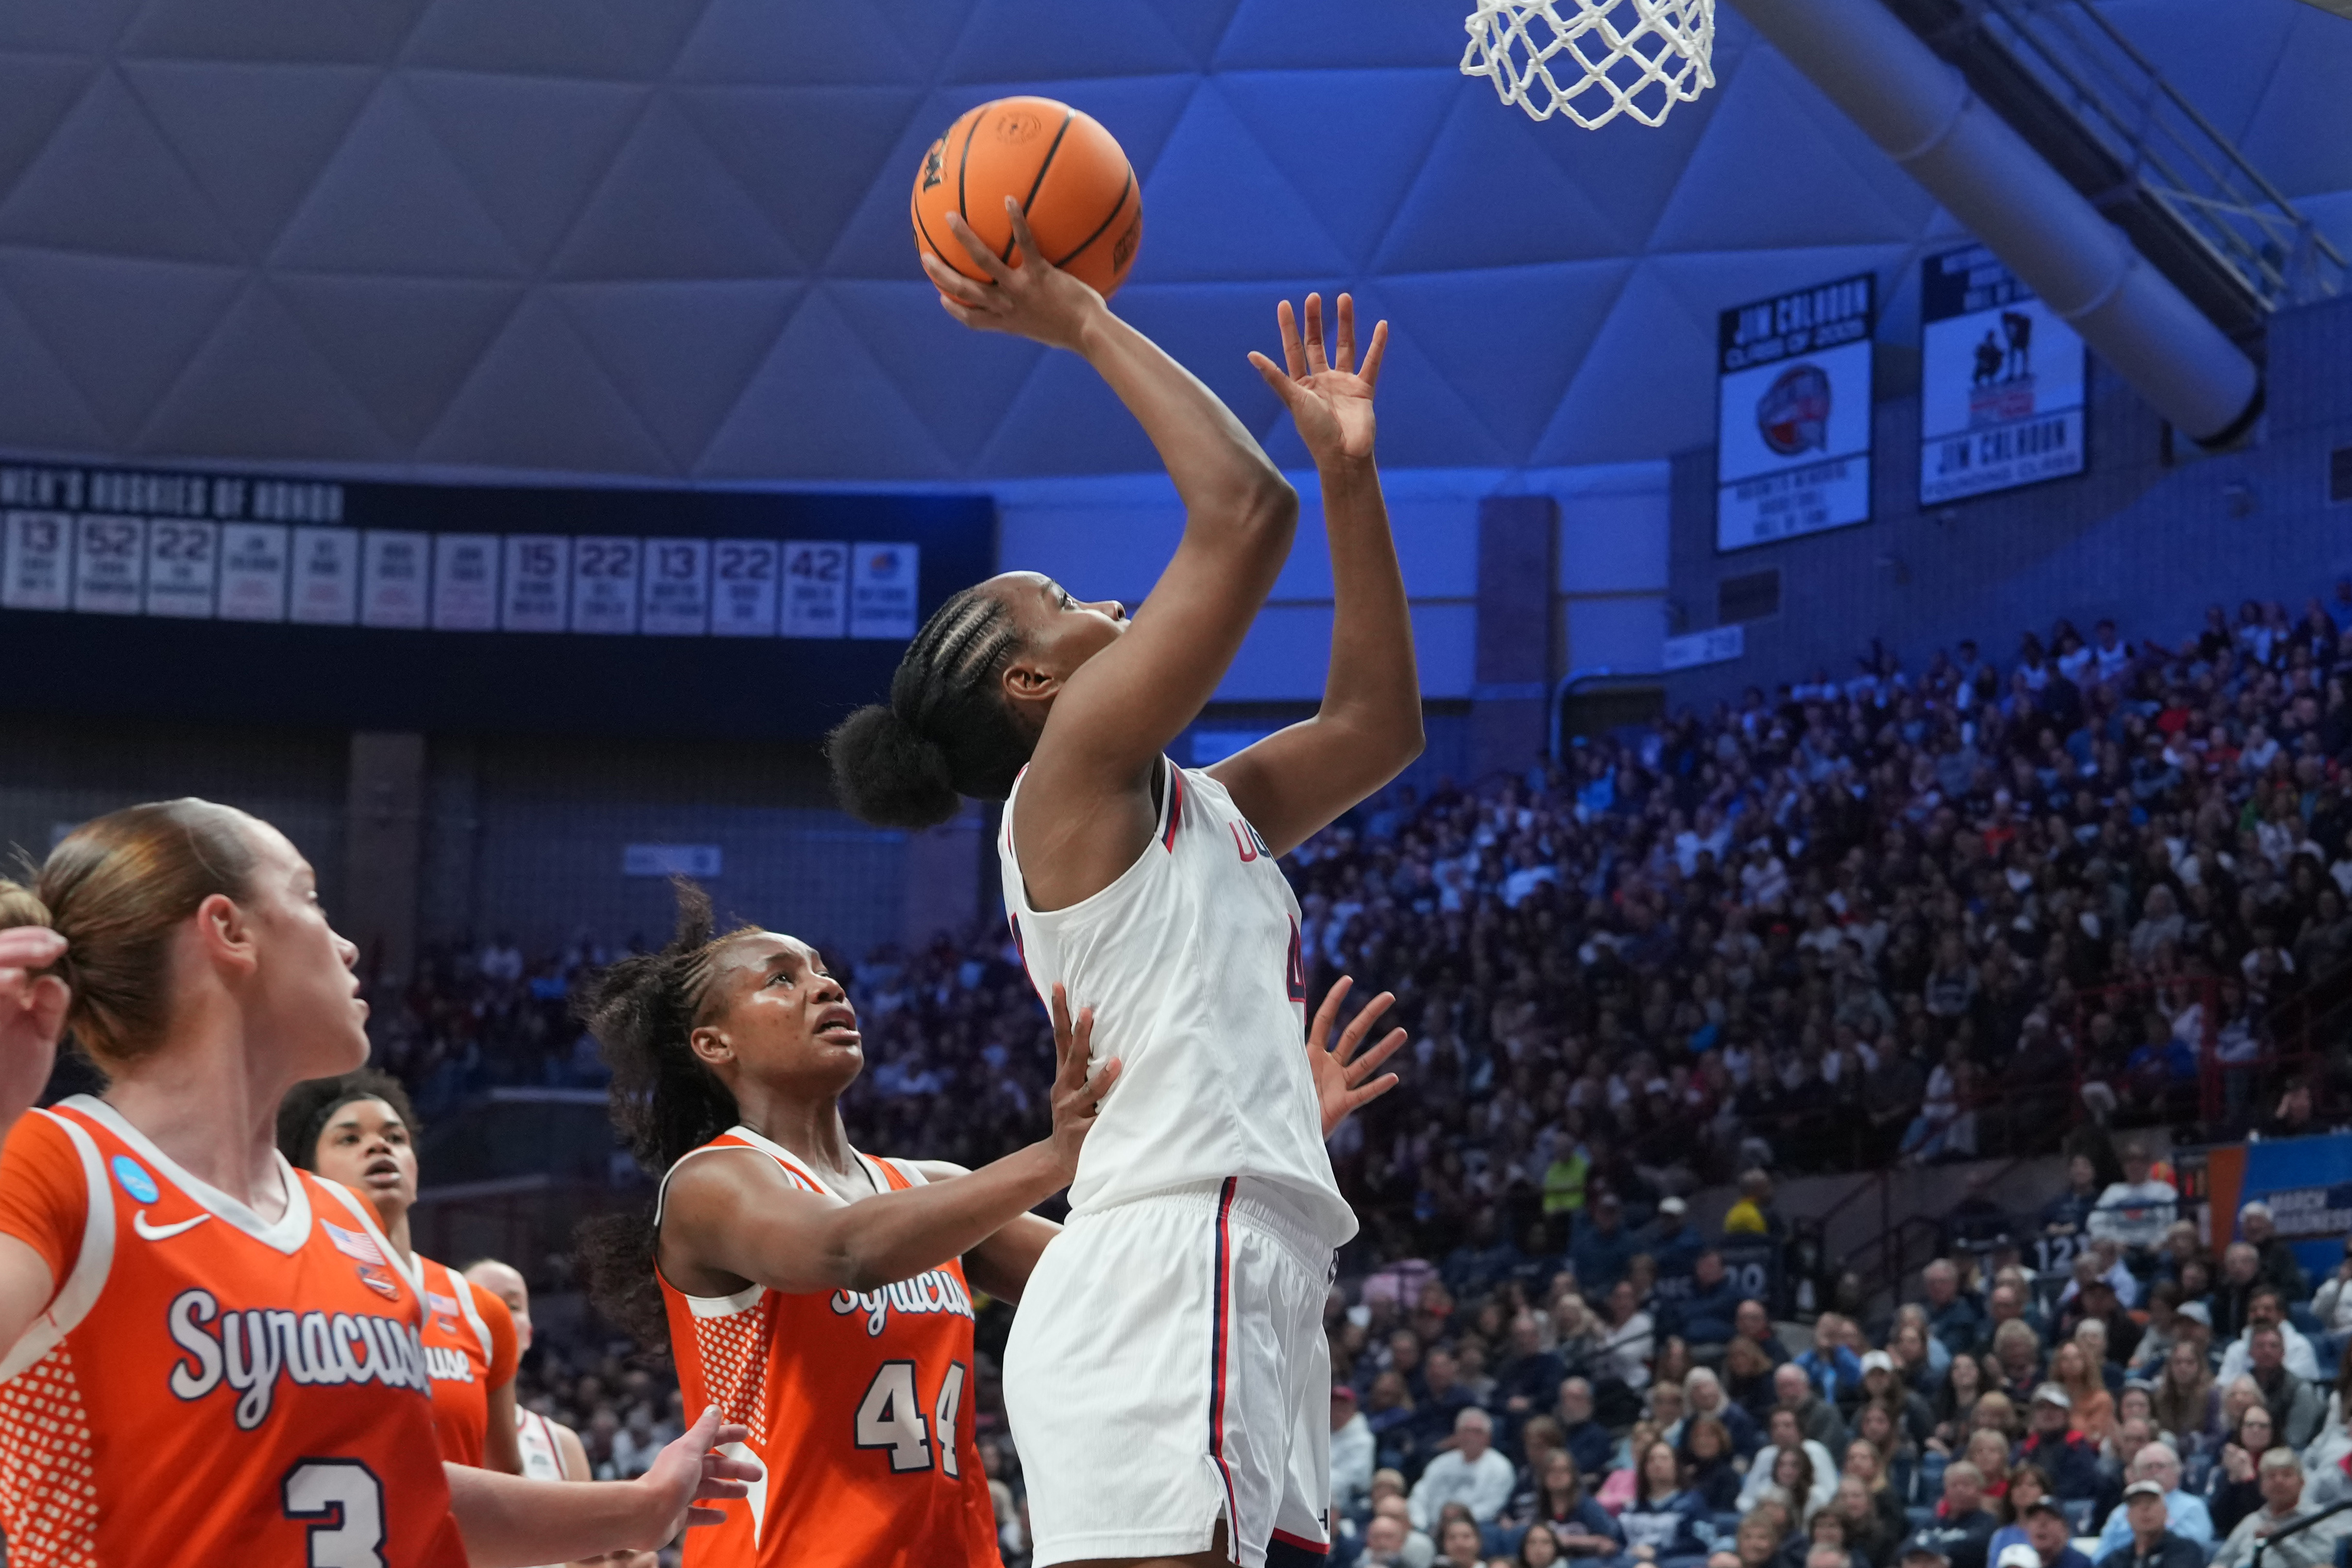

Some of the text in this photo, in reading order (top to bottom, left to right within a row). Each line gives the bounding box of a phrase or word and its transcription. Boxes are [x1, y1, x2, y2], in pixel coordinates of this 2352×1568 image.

[85, 522, 139, 557] 52
[155, 525, 210, 561] 22
[519, 543, 558, 576] 15
[581, 543, 633, 578] 22
[659, 545, 697, 580] 13
[721, 547, 771, 581] 22
[791, 548, 842, 583] 42
[853, 1358, 967, 1481] 44
[281, 1456, 390, 1568] 3
